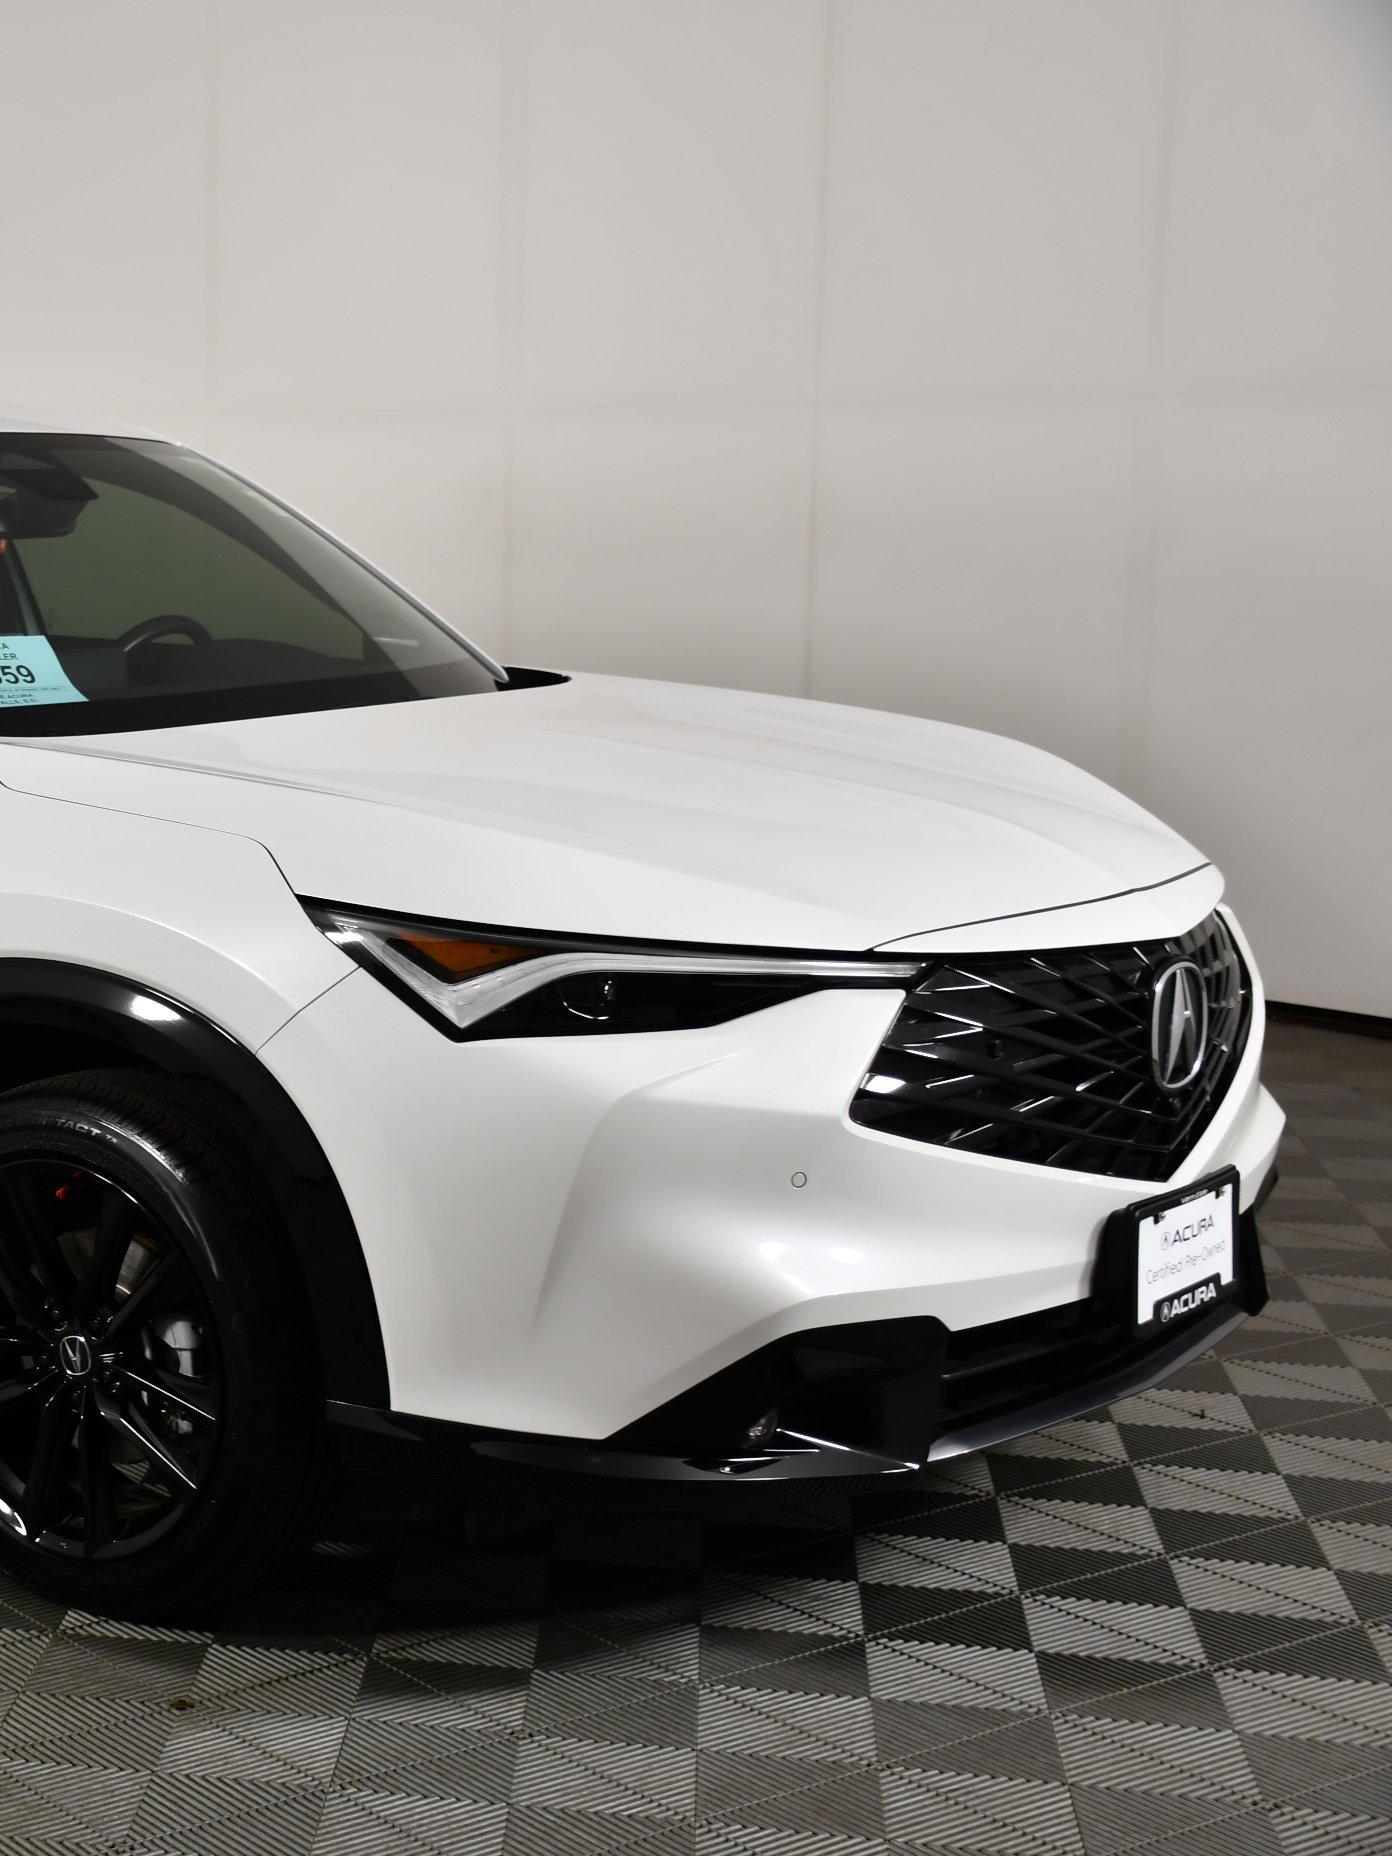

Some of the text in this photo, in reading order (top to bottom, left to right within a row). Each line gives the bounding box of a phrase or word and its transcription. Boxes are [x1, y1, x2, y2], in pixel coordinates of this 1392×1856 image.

[1171, 1215, 1214, 1246] ACURA
[1146, 1239, 1225, 1285] Certified Pre-Owned
[1170, 1282, 1217, 1318] ACURA
